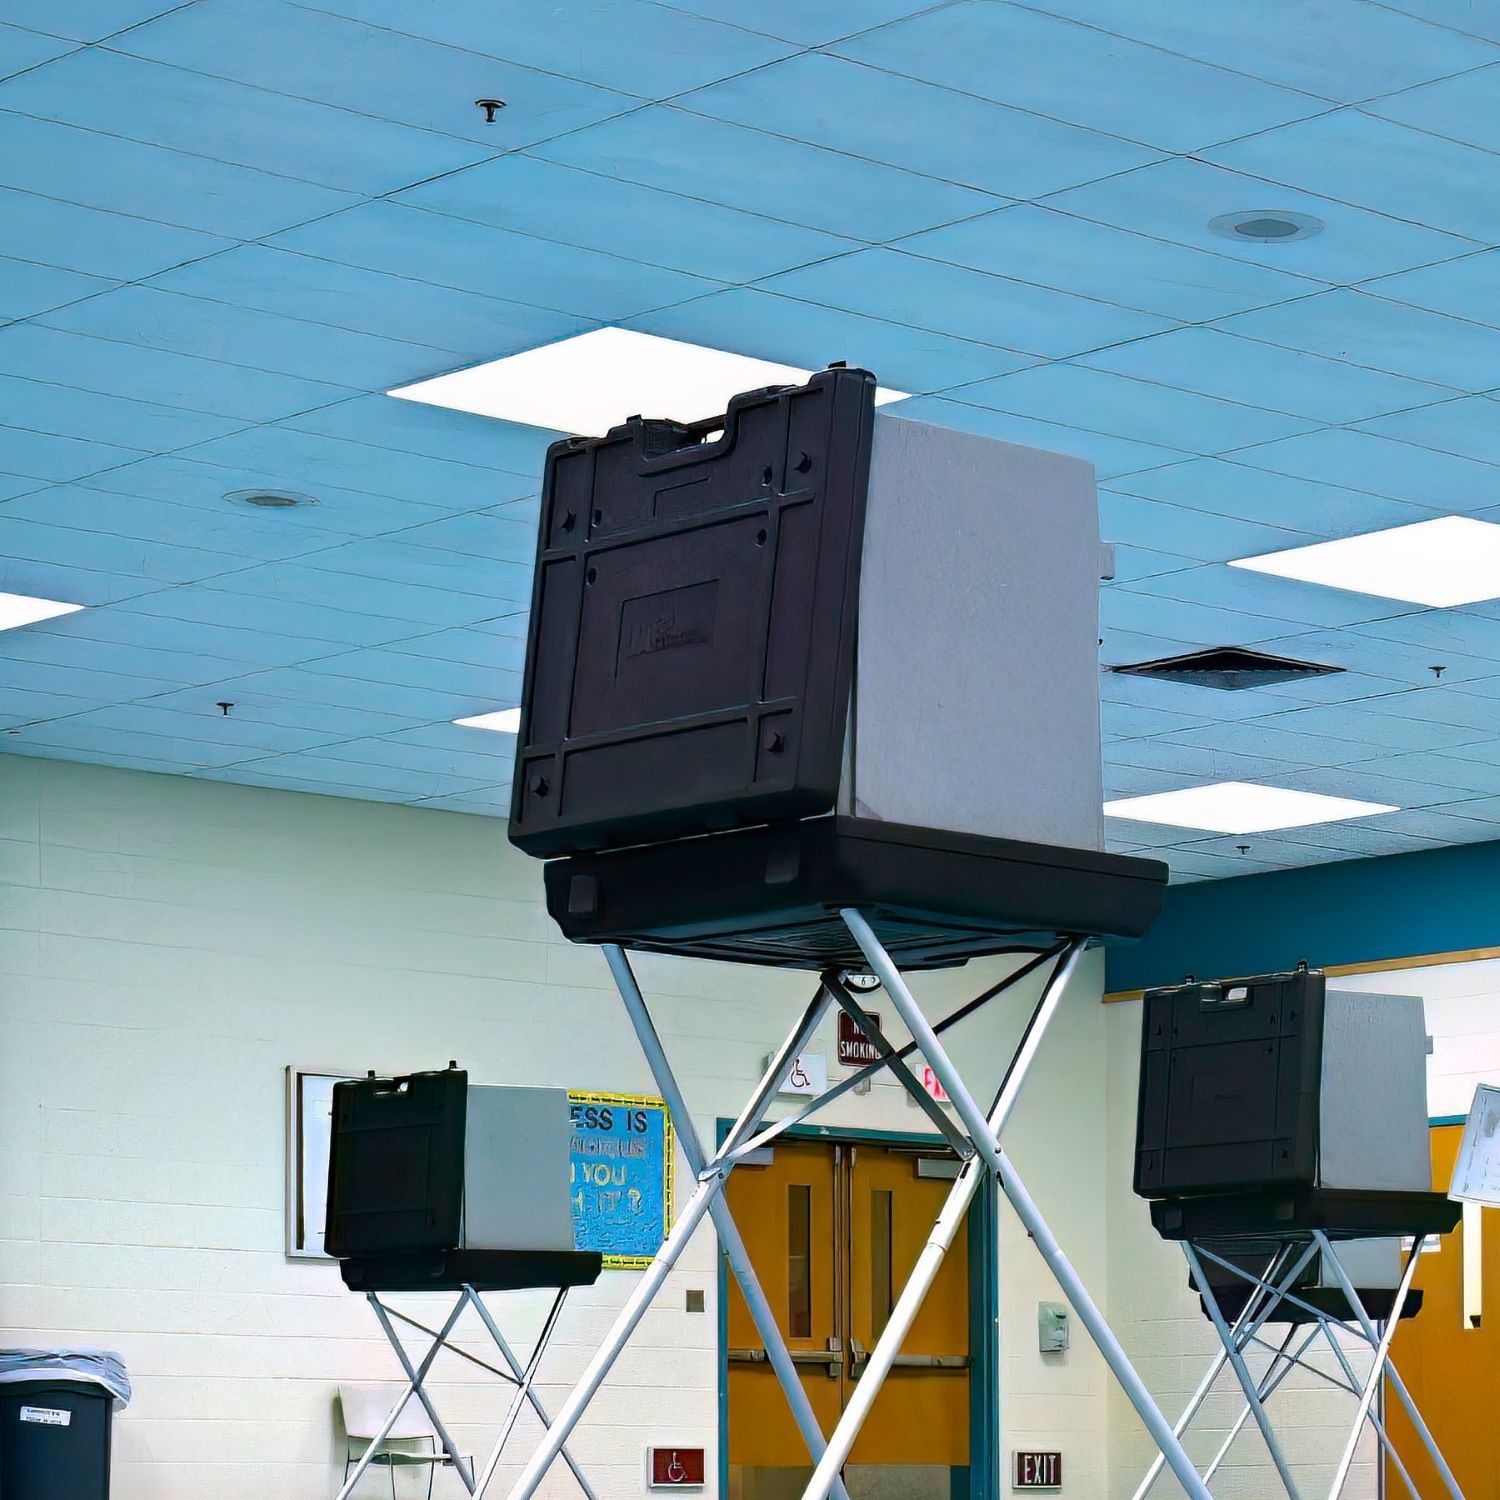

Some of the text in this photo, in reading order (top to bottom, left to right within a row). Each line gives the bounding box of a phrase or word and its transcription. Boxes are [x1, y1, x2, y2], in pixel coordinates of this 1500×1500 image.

[840, 1040, 883, 1060] SMOKING
[627, 1110, 648, 1133] IS
[582, 1161, 627, 1187] YOU
[1023, 1454, 1057, 1484] EXIT
